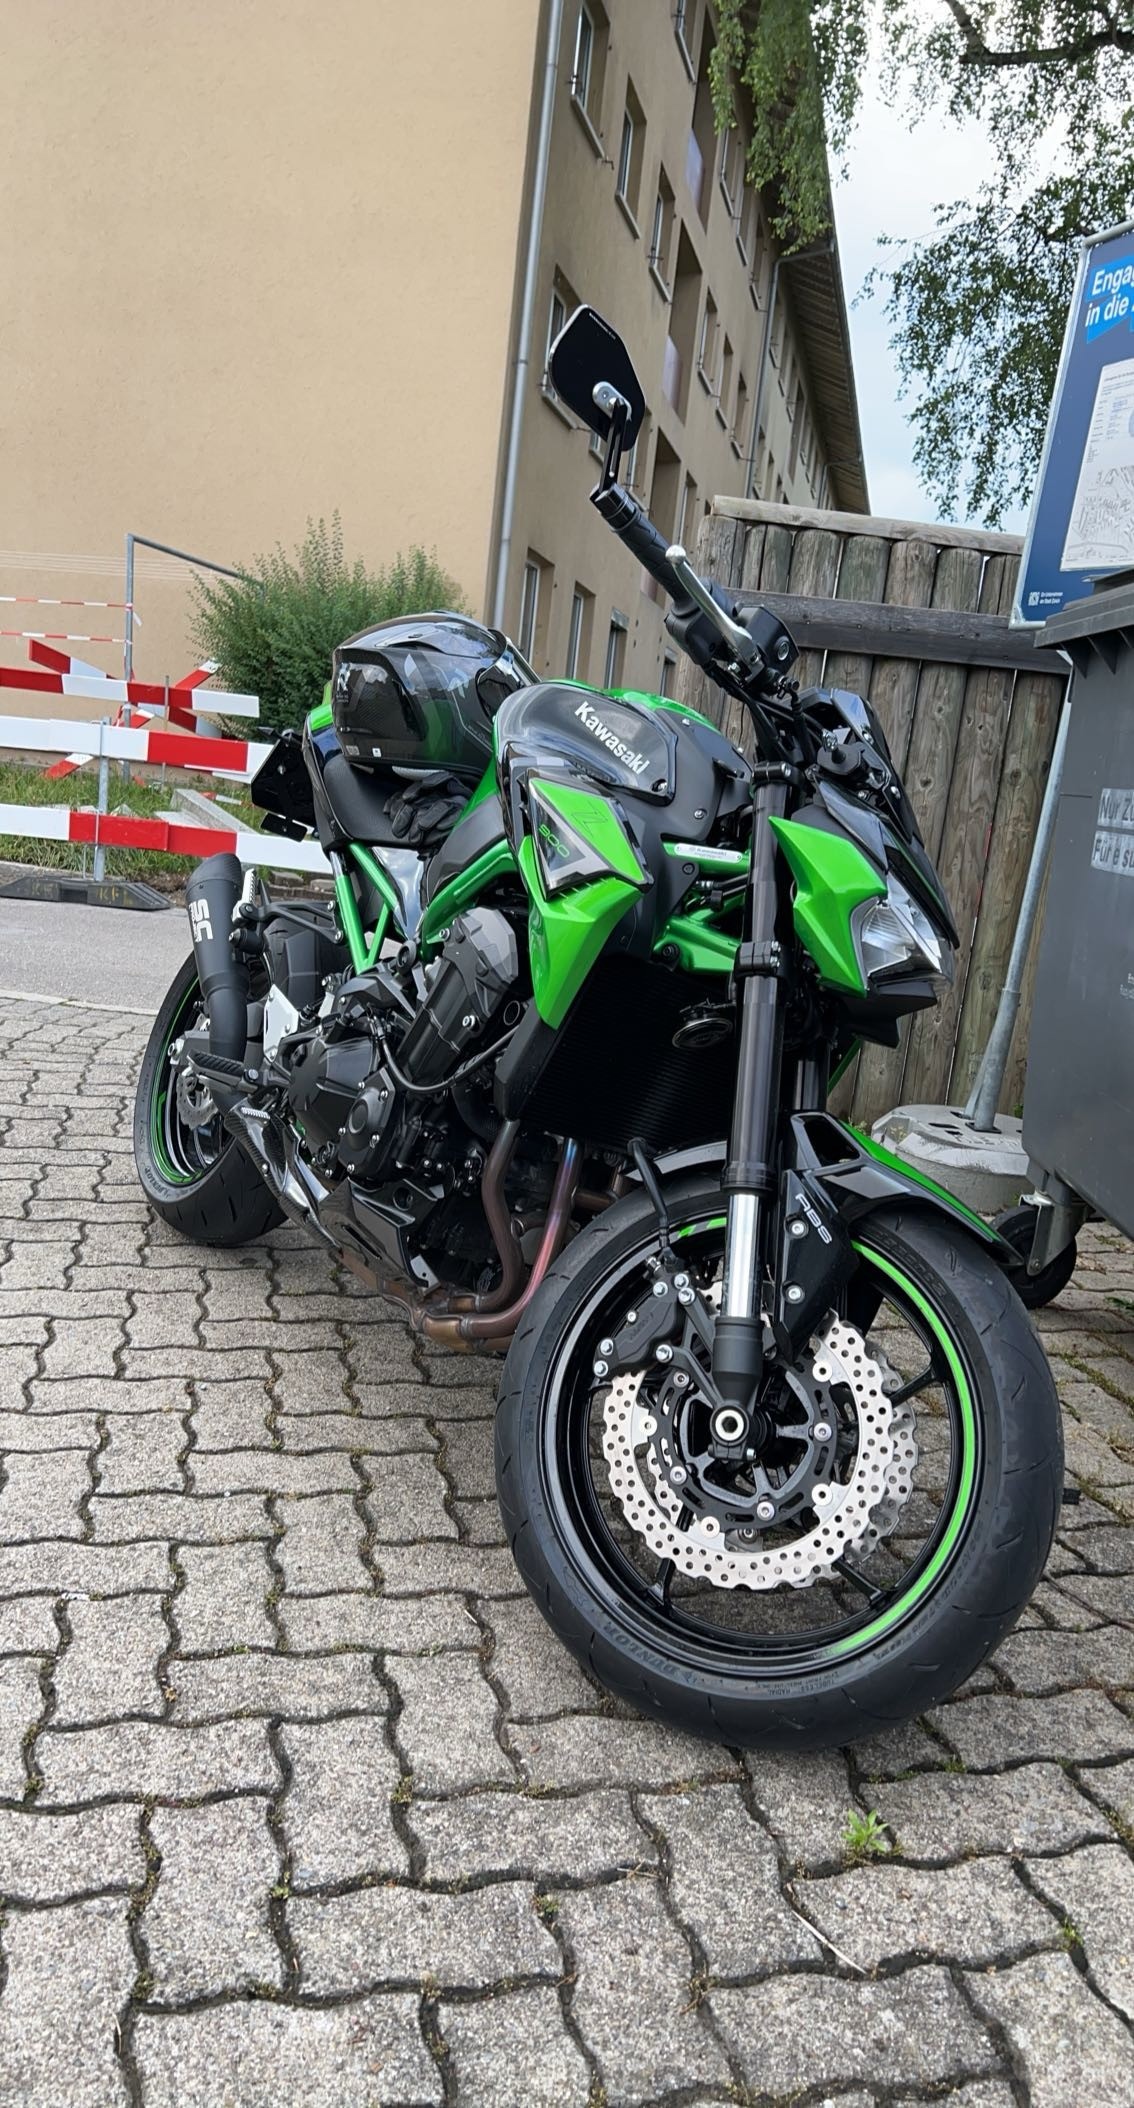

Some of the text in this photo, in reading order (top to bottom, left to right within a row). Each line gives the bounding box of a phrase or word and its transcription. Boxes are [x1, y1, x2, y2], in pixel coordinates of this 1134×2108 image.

[1092, 264, 1134, 295] Enga
[1085, 293, 1129, 327] in die
[574, 700, 650, 775] Kawasaki
[1100, 795, 1120, 820] Nur
[539, 823, 570, 858] 900
[1093, 838, 1112, 863] Für
[795, 1193, 832, 1244] ABS
